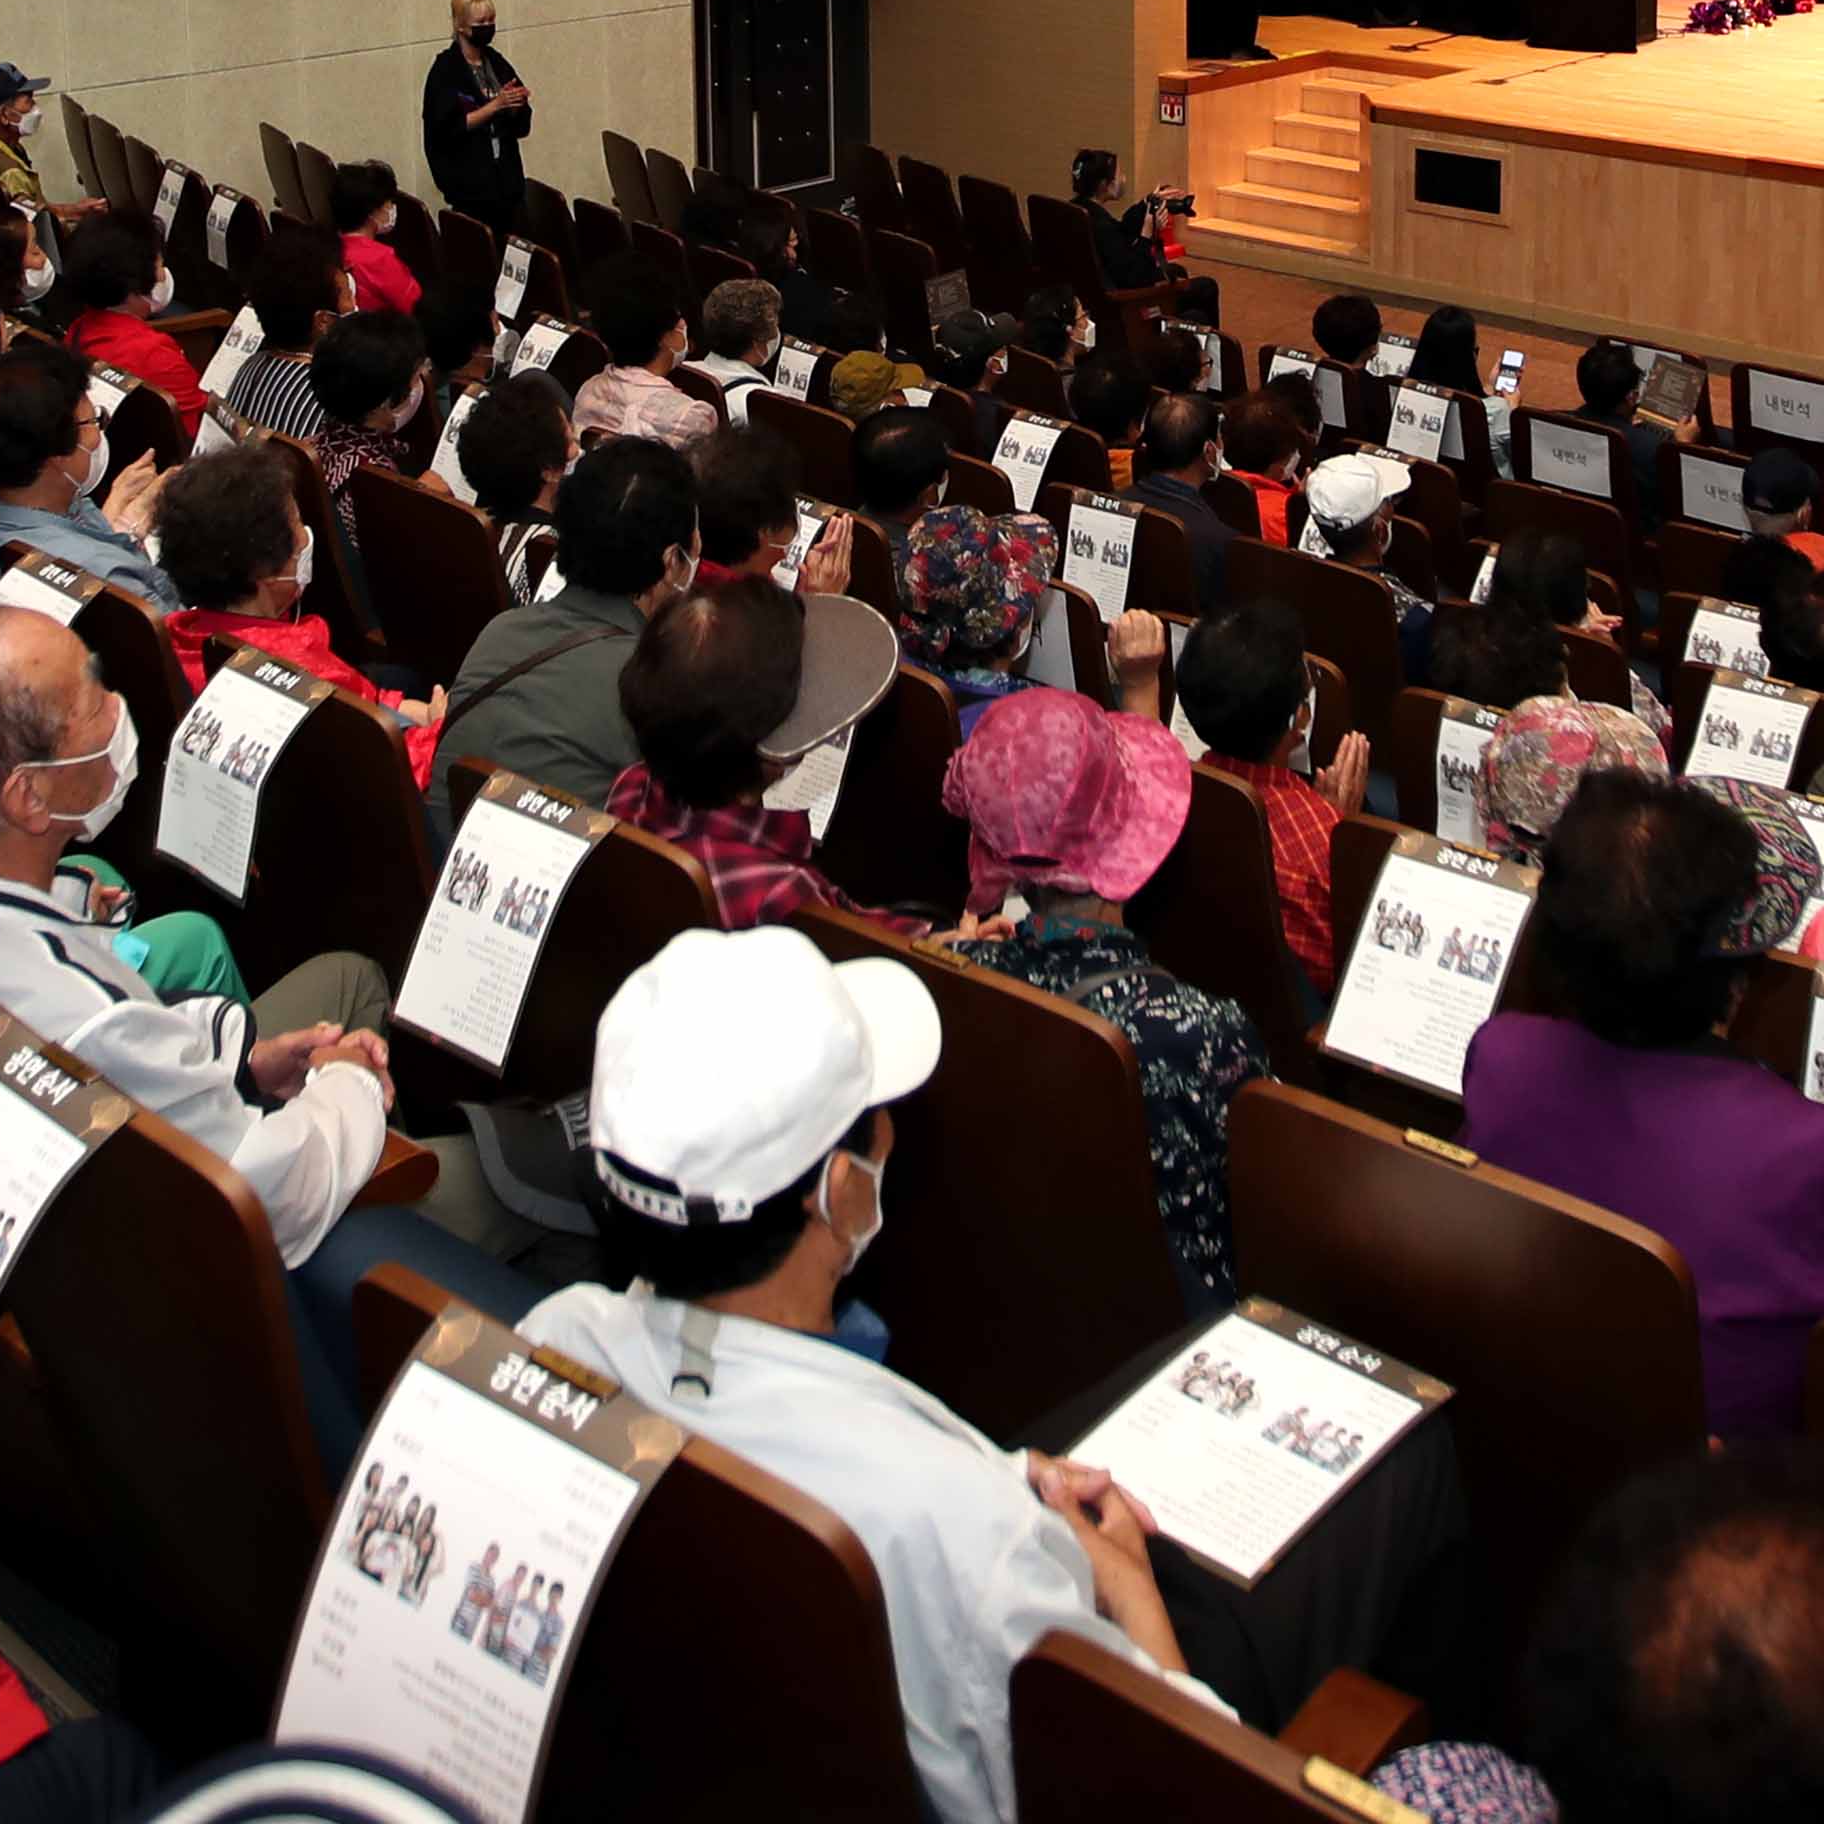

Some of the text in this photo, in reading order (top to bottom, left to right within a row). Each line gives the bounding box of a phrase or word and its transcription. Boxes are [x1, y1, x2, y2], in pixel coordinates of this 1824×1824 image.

[1764, 393, 1811, 419] 내빈석
[489, 1351, 601, 1433] 공연 순서
